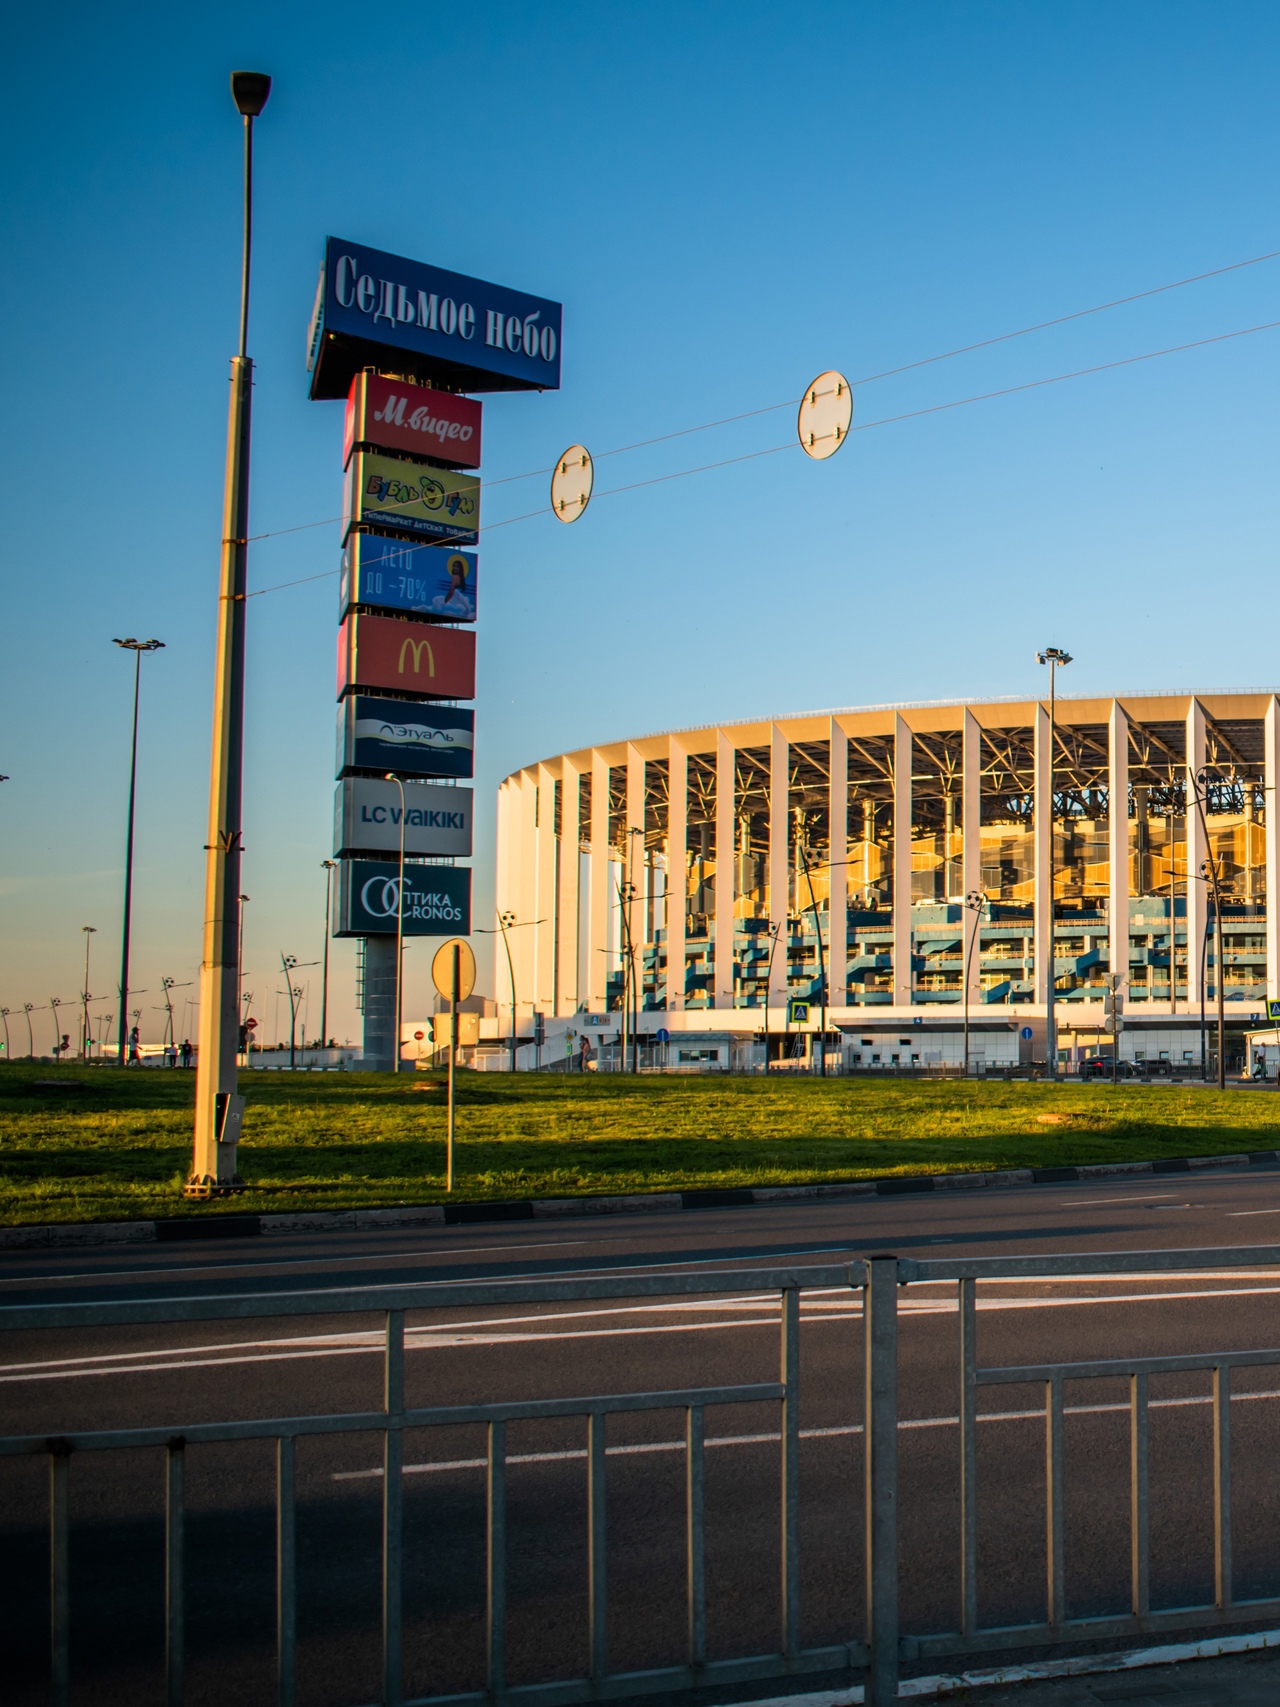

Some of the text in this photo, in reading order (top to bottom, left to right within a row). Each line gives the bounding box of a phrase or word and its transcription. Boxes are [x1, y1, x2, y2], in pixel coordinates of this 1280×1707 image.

[335, 255, 476, 340] Седьмое
[485, 309, 556, 362] небо
[374, 394, 473, 443] М.видео
[366, 475, 475, 517] БУБЛЬ ГУМ
[381, 545, 412, 571] ЛЕТО
[366, 571, 383, 594] ДО
[361, 805, 387, 824] LC
